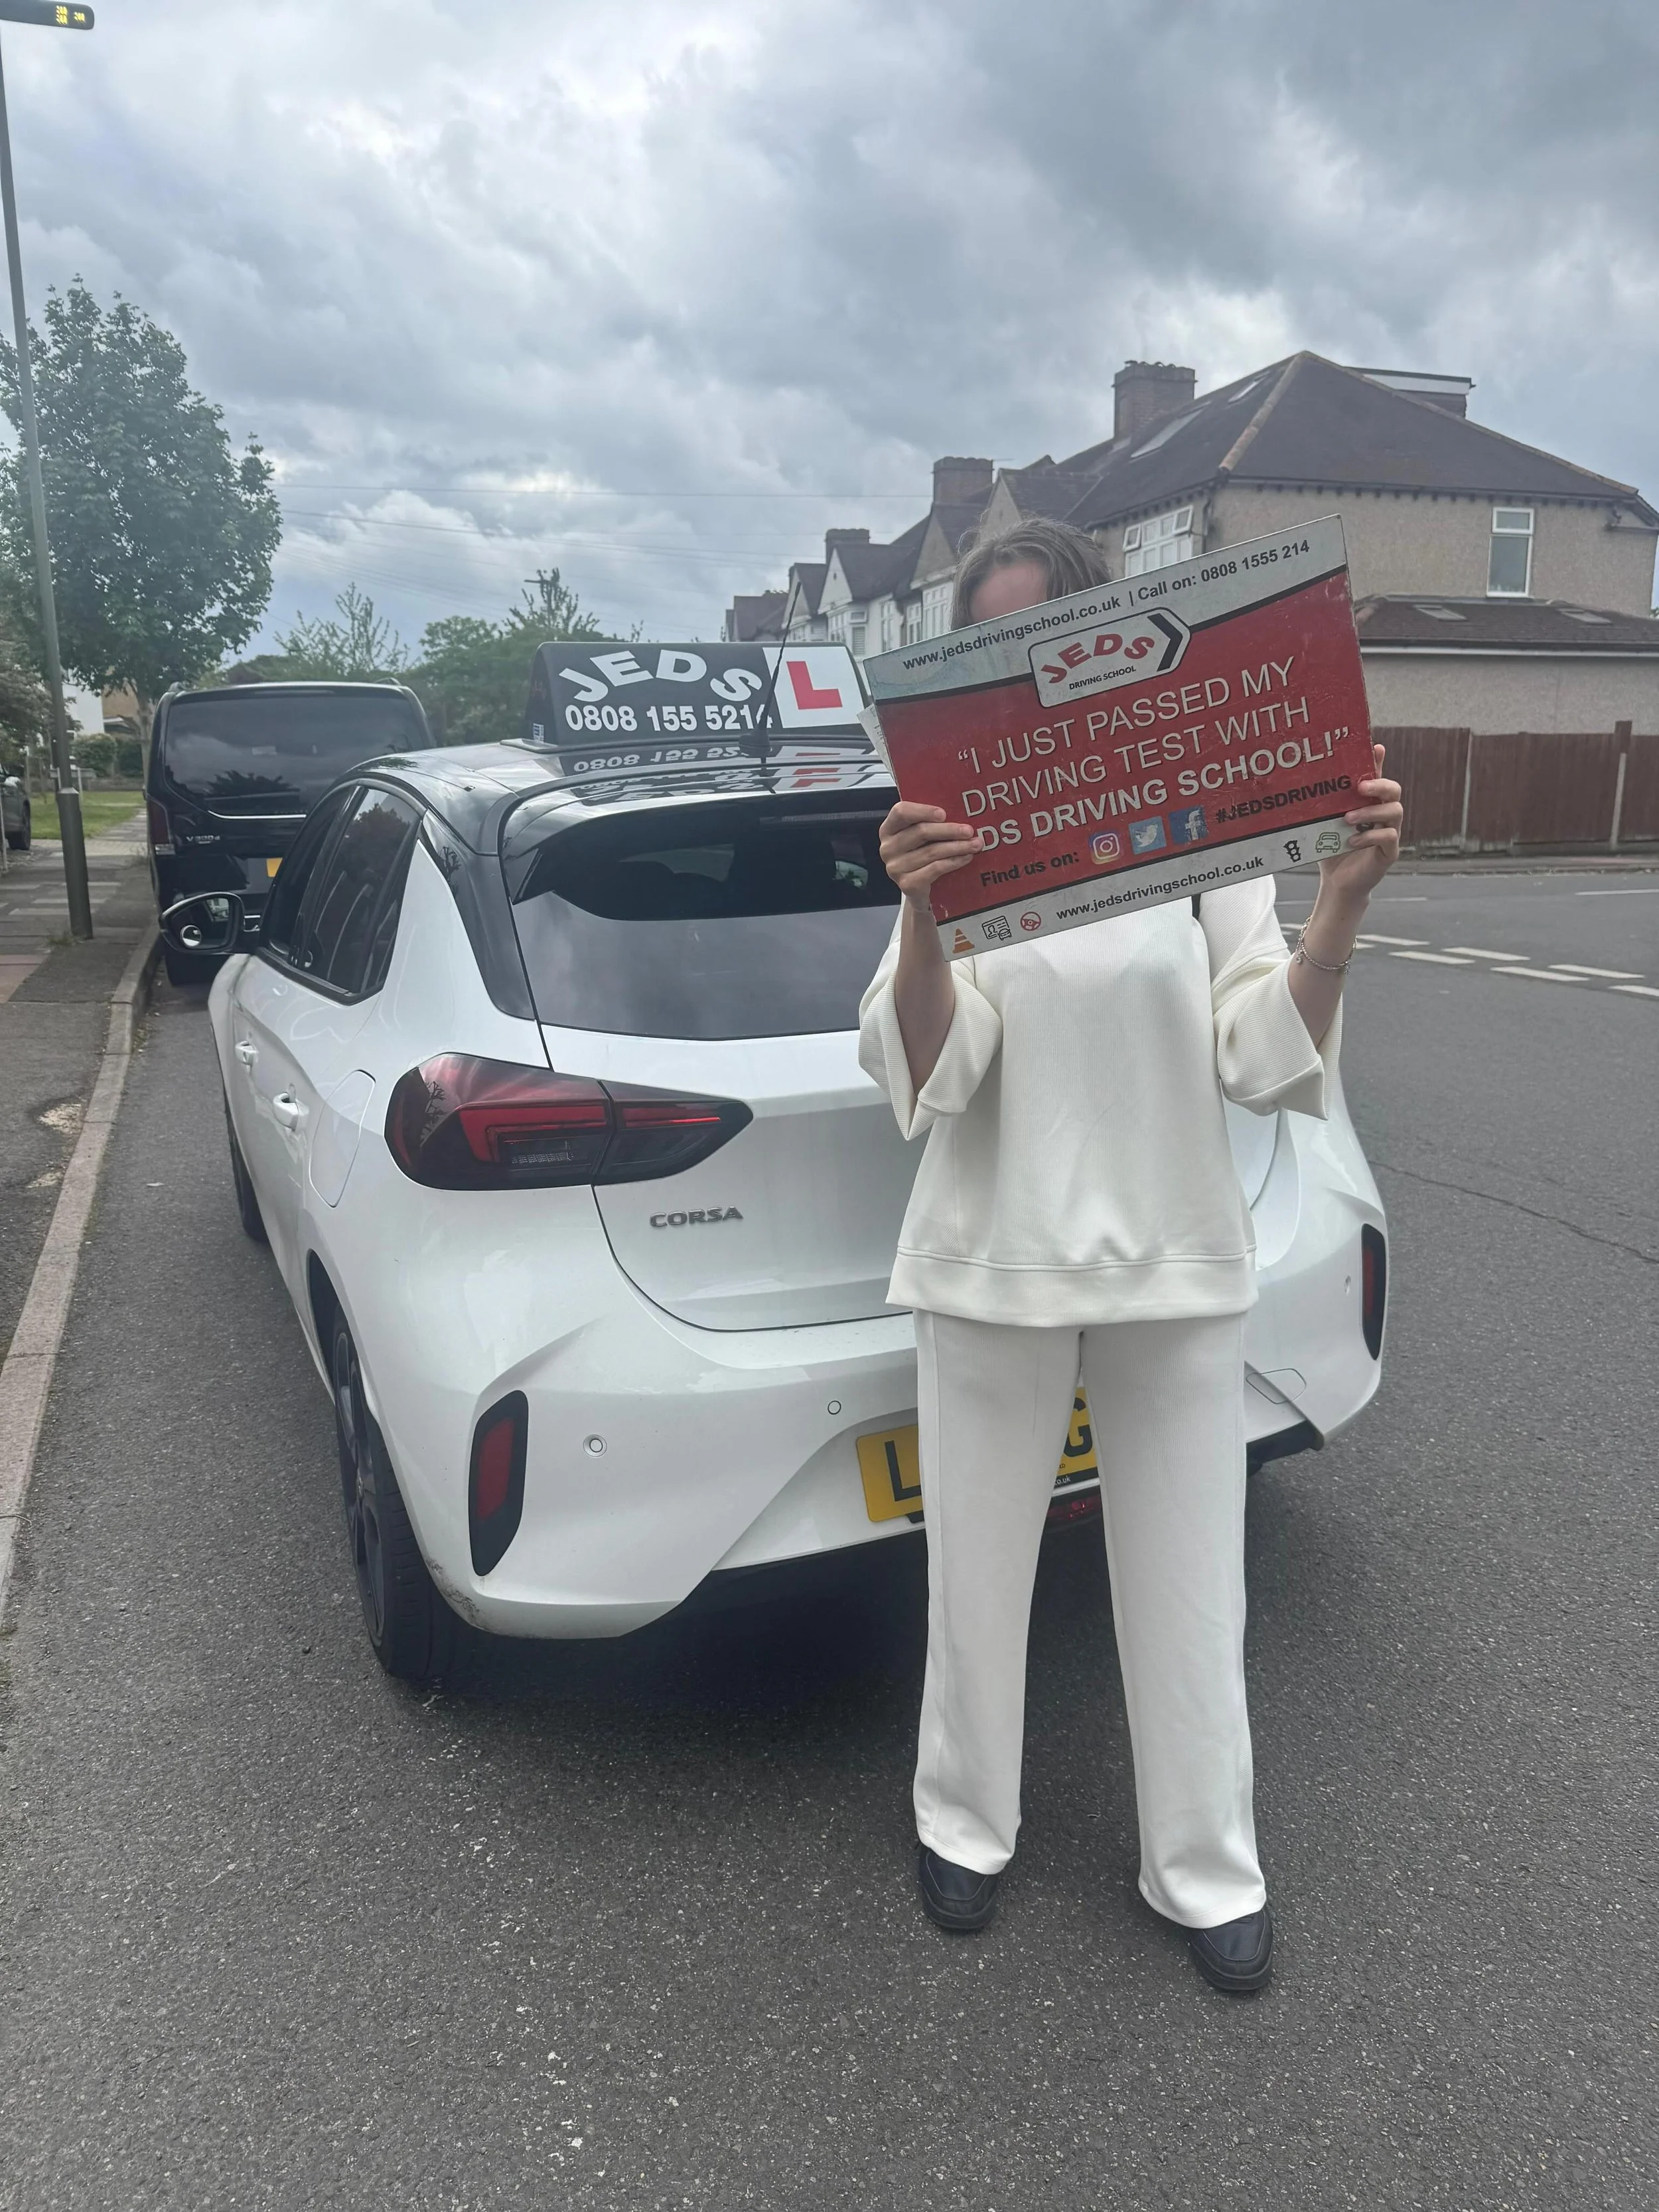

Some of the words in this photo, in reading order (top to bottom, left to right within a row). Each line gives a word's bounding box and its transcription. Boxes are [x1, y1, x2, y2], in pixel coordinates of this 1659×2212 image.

[903, 596, 1121, 670] www.jedsdrivingschool.co.uk
[1137, 581, 1168, 600] Call
[1171, 575, 1197, 591] on:
[1201, 561, 1238, 582] 0808
[1242, 549, 1279, 570] 1555
[1282, 540, 1310, 560] 214
[559, 650, 762, 702] JEDS
[786, 660, 843, 710] L
[1041, 633, 1155, 684] JEDS
[1069, 675, 1102, 690] DRIVING
[1103, 665, 1137, 680] SCHOOL
[565, 704, 638, 731] 0808
[646, 705, 697, 731] 155
[991, 719, 1076, 769] JUST
[1086, 676, 1230, 741] PASSED
[1241, 656, 1295, 698] MY
[962, 755, 1107, 818] DRIVING
[1114, 724, 1207, 774] TEST
[1215, 696, 1310, 746] WITH
[976, 819, 1022, 852] DS
[1030, 779, 1168, 838] DRIVING
[980, 864, 1020, 888] Find
[1024, 861, 1046, 877] us
[1050, 852, 1080, 870] on:
[1215, 774, 1351, 824] #JEDSDRIVING
[1056, 855, 1264, 921] www.jedsdrivingschool.co.uk
[650, 1206, 744, 1228] CORSA
